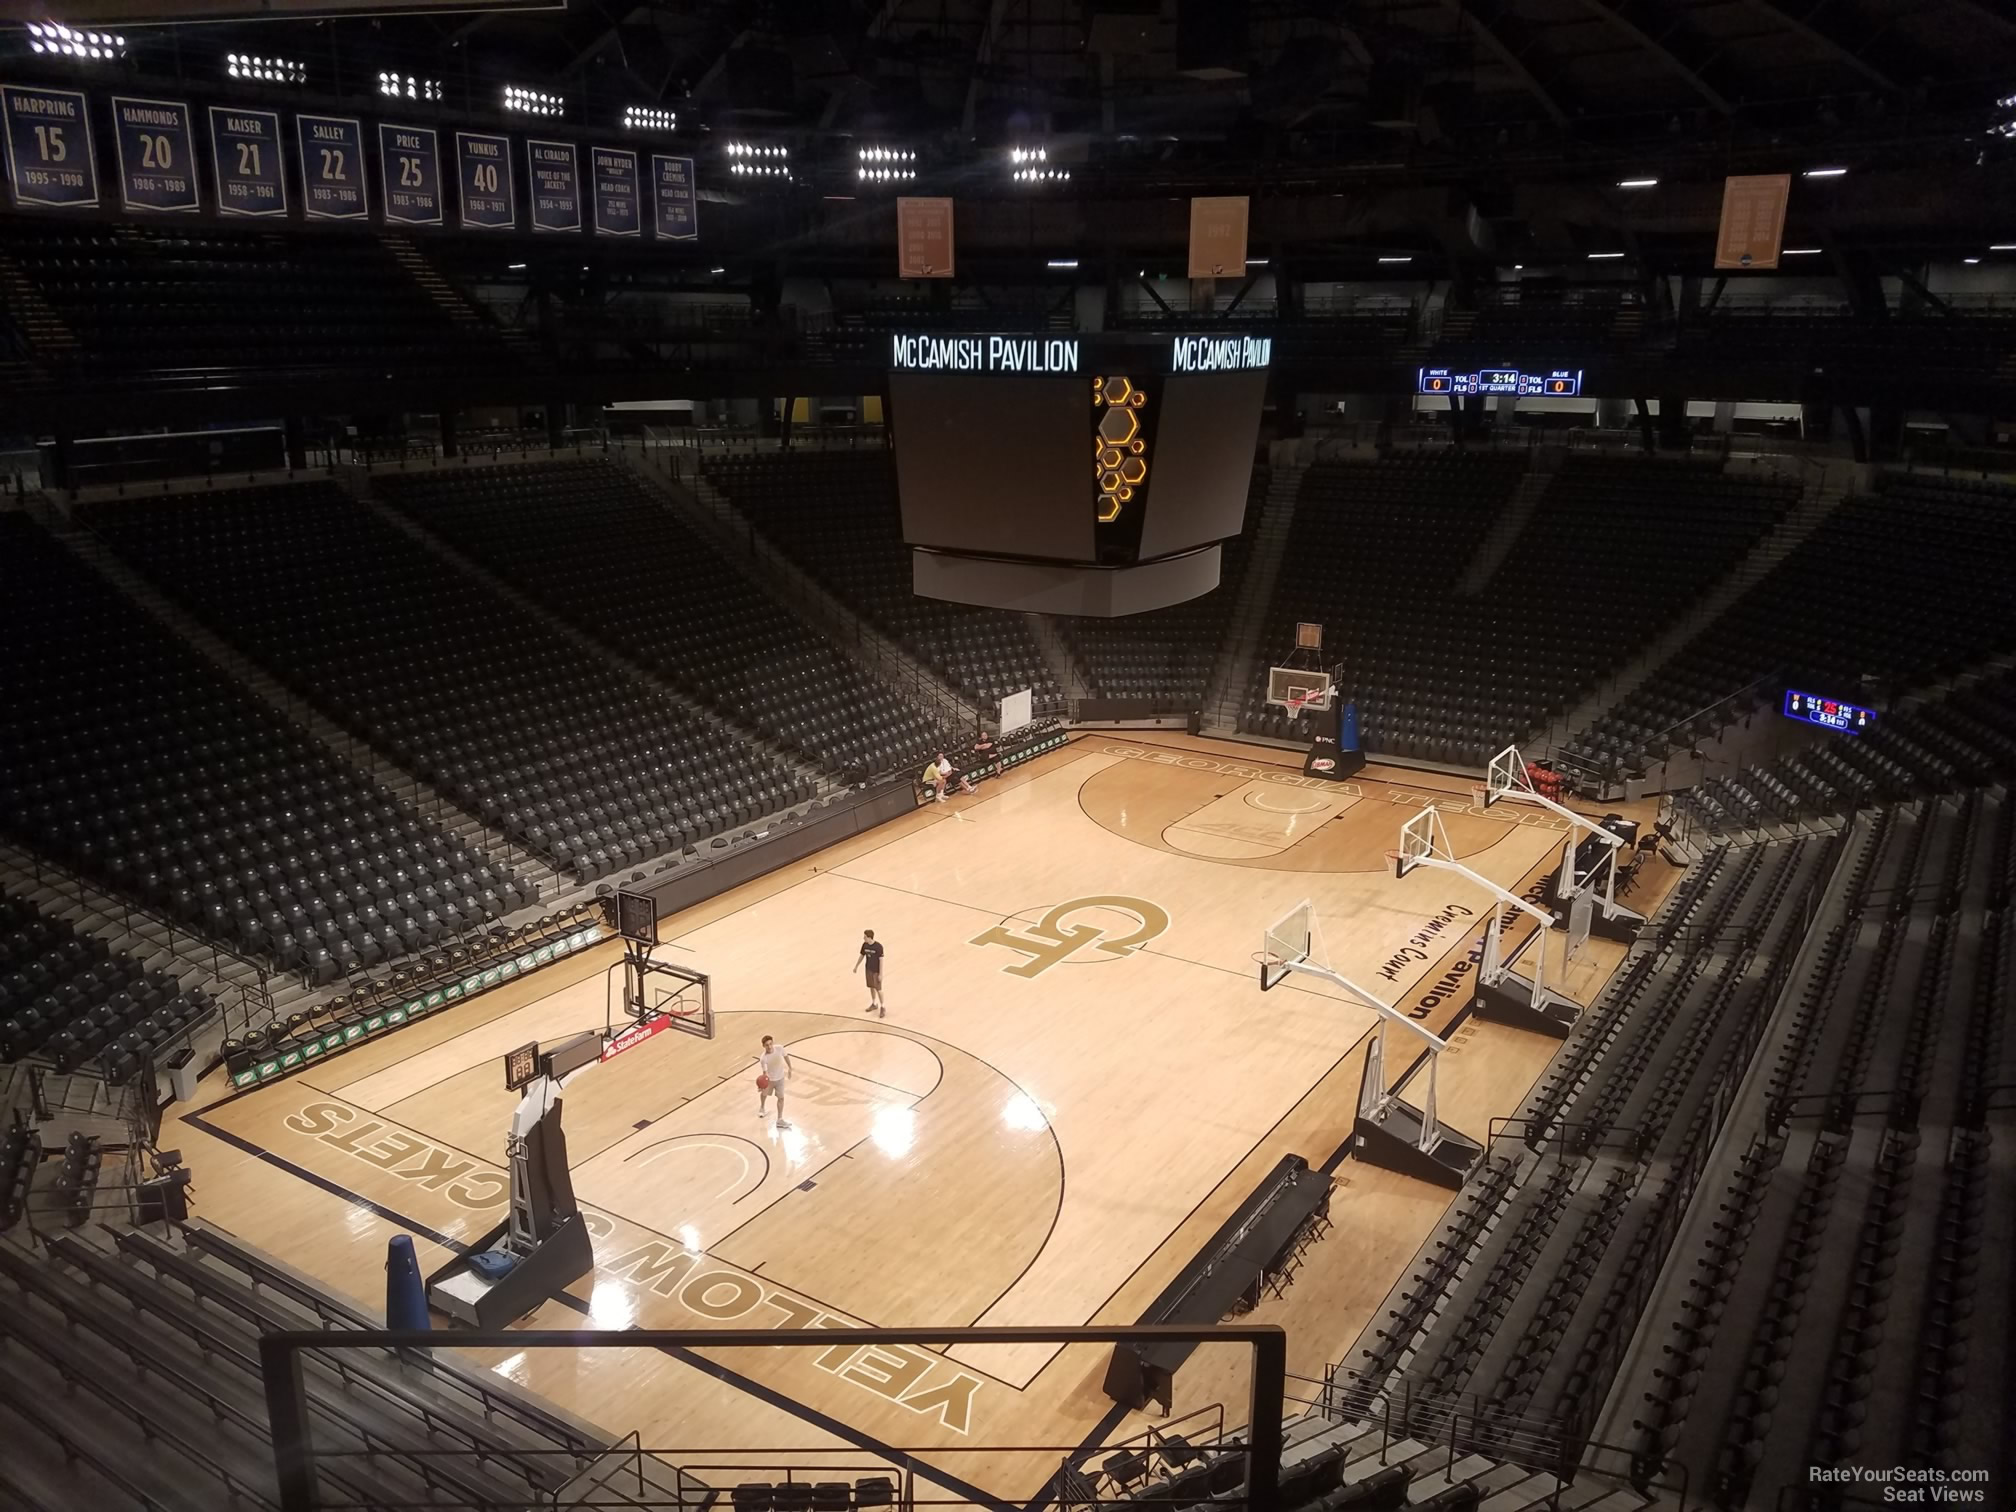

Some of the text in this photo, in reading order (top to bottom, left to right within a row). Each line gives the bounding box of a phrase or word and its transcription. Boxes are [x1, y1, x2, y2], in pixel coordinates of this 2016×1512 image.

[13, 97, 75, 117] HARPRING
[123, 107, 179, 126] HAMMONDS
[227, 117, 262, 134] KAISER
[313, 125, 344, 140] SALLEY
[34, 125, 66, 162] 15
[396, 134, 420, 149] PRICE
[467, 141, 498, 157] YUNKUS
[139, 134, 172, 169] 20
[236, 142, 261, 175] 21
[535, 148, 570, 162] AL CIRALDO
[320, 148, 346, 180] 22
[597, 155, 613, 168] JOHN
[25, 171, 49, 185] 1995
[60, 174, 83, 187] 1998
[400, 157, 422, 187] 25
[474, 163, 498, 193] 40
[537, 170, 571, 181] VOICE OF THE
[133, 178, 155, 191] 1986
[164, 180, 186, 192] 1989
[228, 184, 248, 196] 1958
[256, 186, 274, 198] 1961
[313, 188, 331, 200] 1983
[338, 190, 357, 201] 1986
[393, 194, 409, 206] 1983
[989, 336, 1078, 372] PAVILION
[1242, 337, 1272, 369] PAVILION
[1432, 379, 1441, 391] 0
[1492, 374, 1516, 384] 3:14
[1555, 381, 1564, 392] 0
[1792, 700, 1799, 710] 0
[1824, 702, 1837, 714] 25
[1819, 713, 1836, 724] 3:14
[1321, 737, 1336, 745] PNC
[1103, 744, 1363, 797] GEORGIA
[1388, 789, 1574, 831] TECH
[1376, 904, 1474, 982] Cremins Court
[1408, 950, 1482, 1020] Pavilion
[616, 1028, 652, 1052] StateFarm
[598, 1240, 984, 1437] YELLOW
